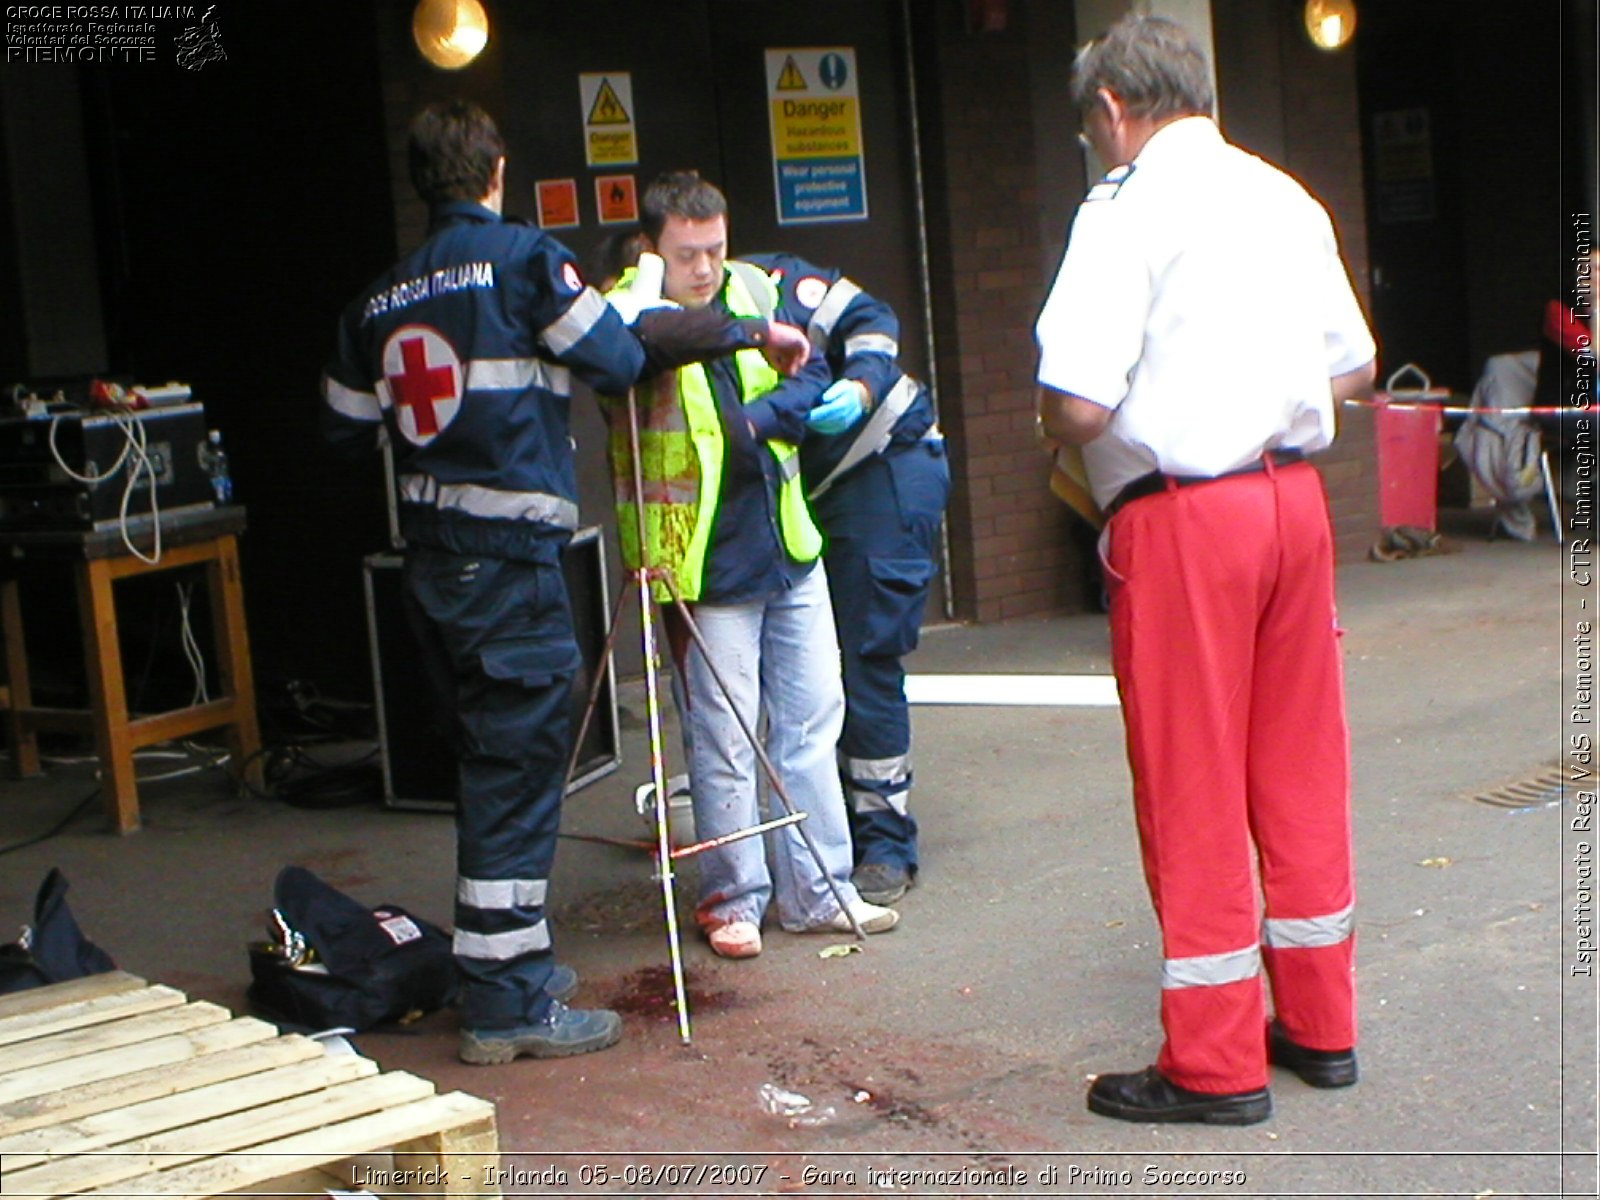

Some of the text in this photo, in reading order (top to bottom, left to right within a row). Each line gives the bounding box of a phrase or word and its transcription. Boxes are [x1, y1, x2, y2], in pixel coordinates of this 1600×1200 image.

[783, 98, 846, 120] Danger
[590, 130, 632, 145] Danger
[432, 262, 494, 295] ITALIANA
